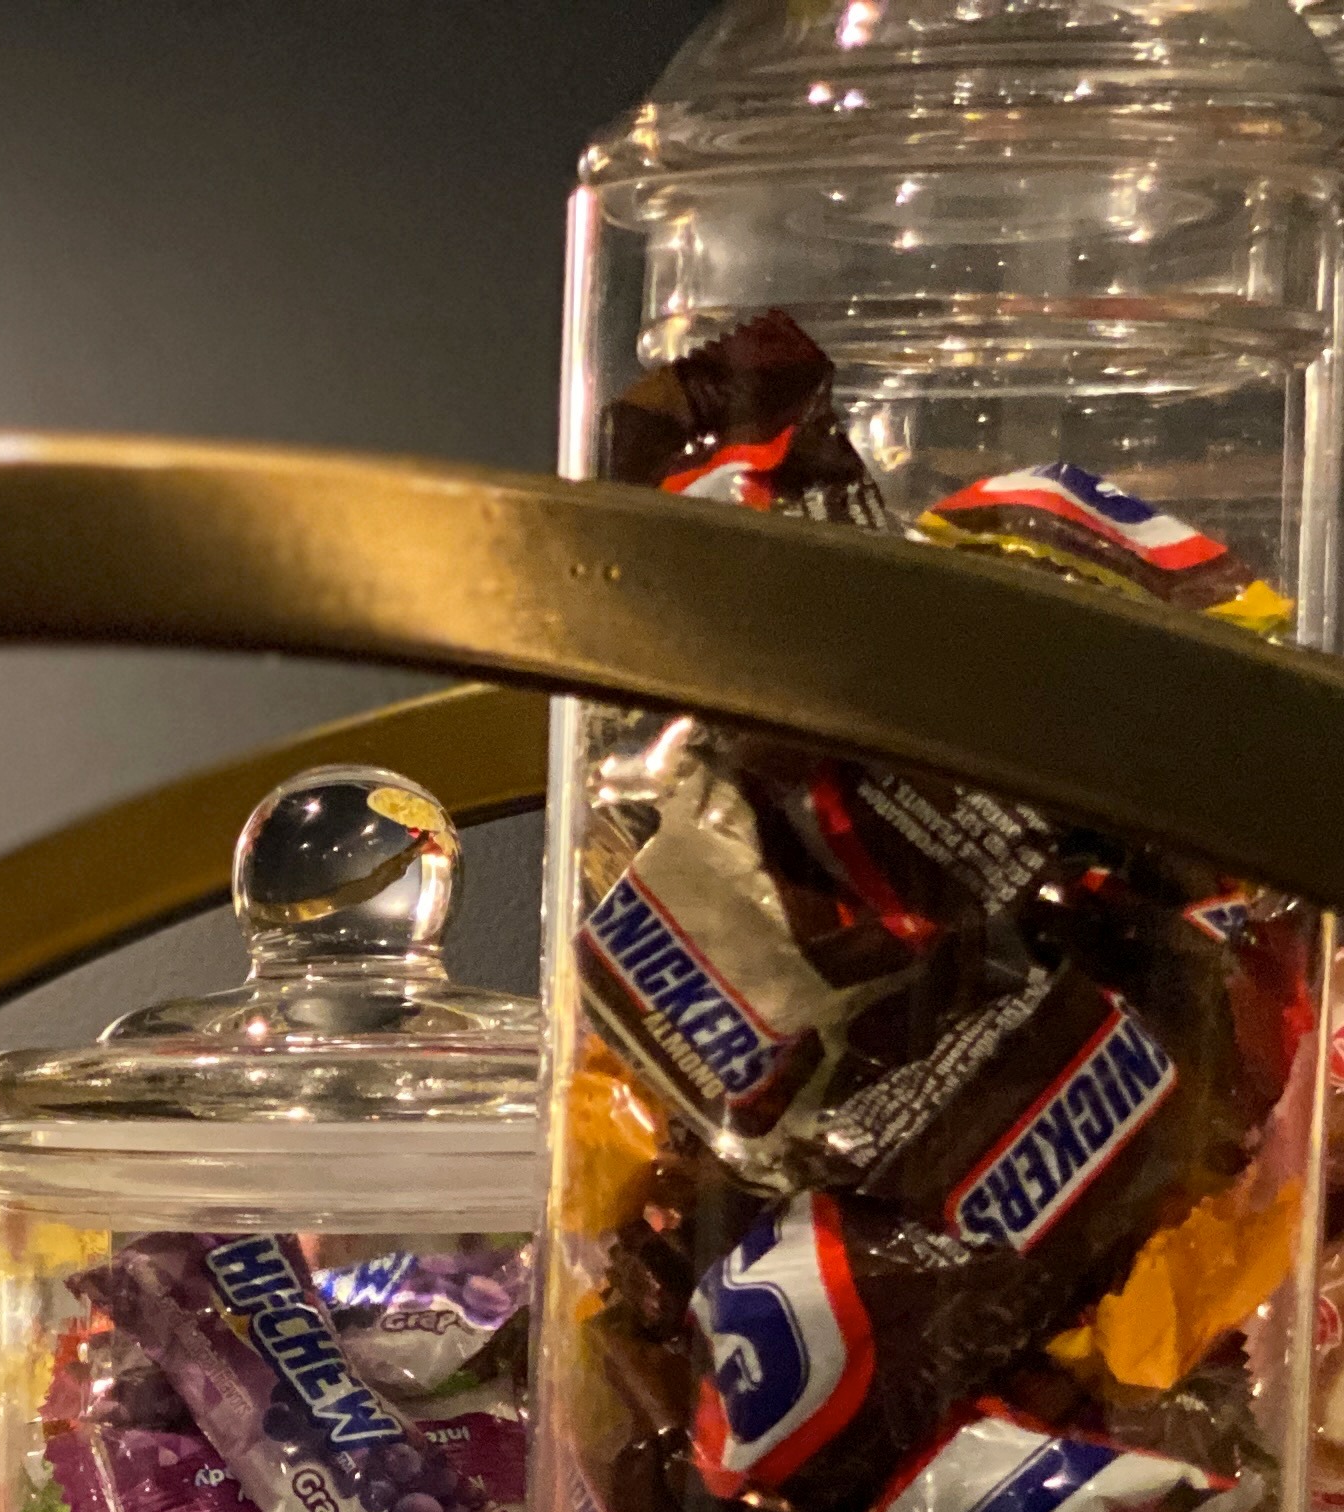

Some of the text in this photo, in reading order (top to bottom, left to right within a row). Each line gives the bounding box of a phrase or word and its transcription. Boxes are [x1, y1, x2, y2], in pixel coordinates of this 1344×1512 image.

[591, 878, 784, 1095] SNICKERS
[641, 1008, 726, 1102] ALMOND
[960, 1016, 1170, 1242] NICKERS
[205, 1236, 402, 1447] HI-CHEW
